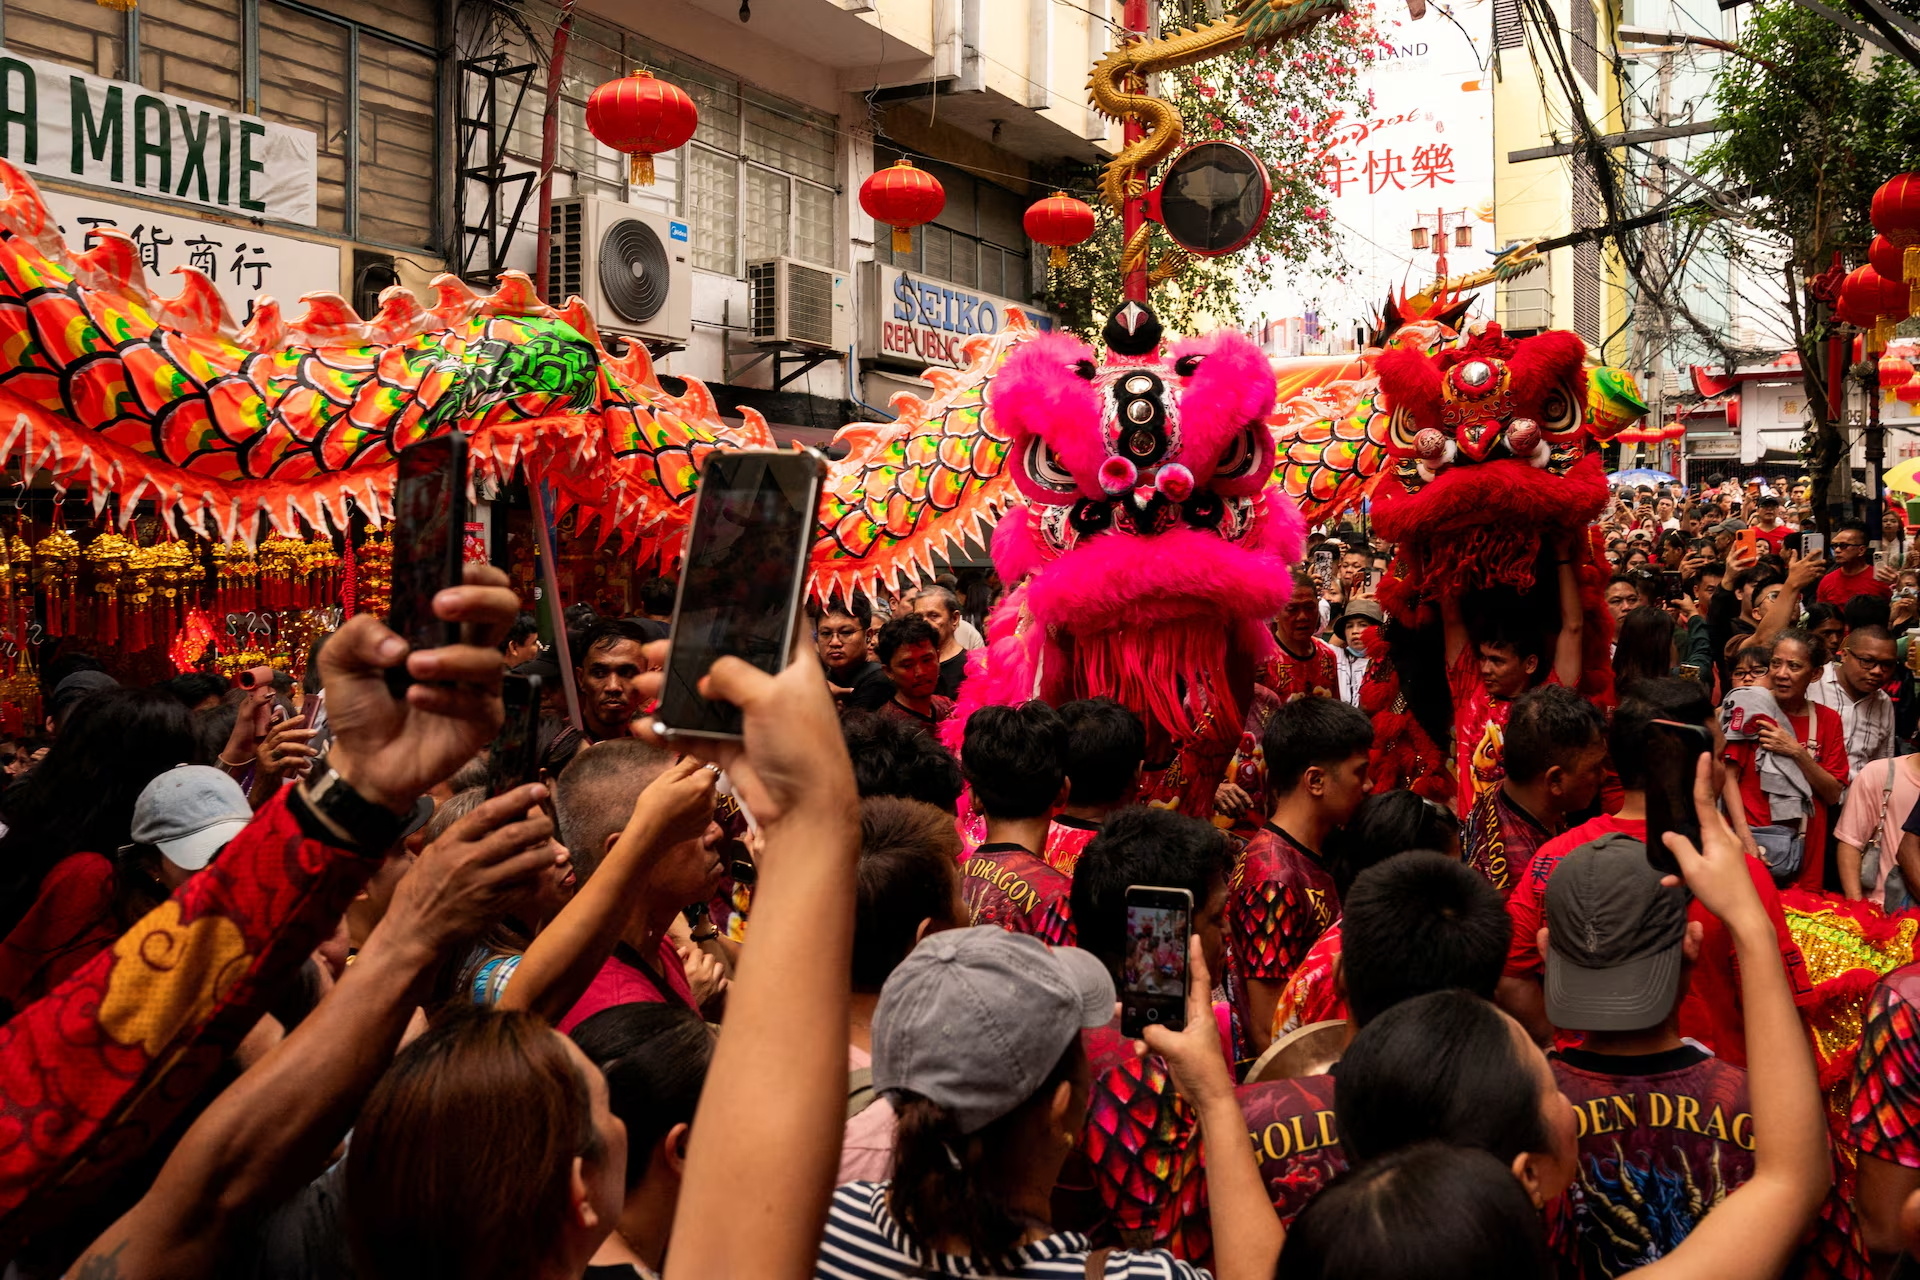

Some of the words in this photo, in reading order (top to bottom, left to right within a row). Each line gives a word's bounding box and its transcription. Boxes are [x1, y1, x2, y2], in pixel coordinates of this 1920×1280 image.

[69, 74, 266, 213] MAXIE
[1292, 143, 1456, 198] 年快樂
[893, 275, 998, 336] SEIKO
[883, 321, 961, 364] REPUBLIC
[970, 858, 1041, 916] DRAGON
